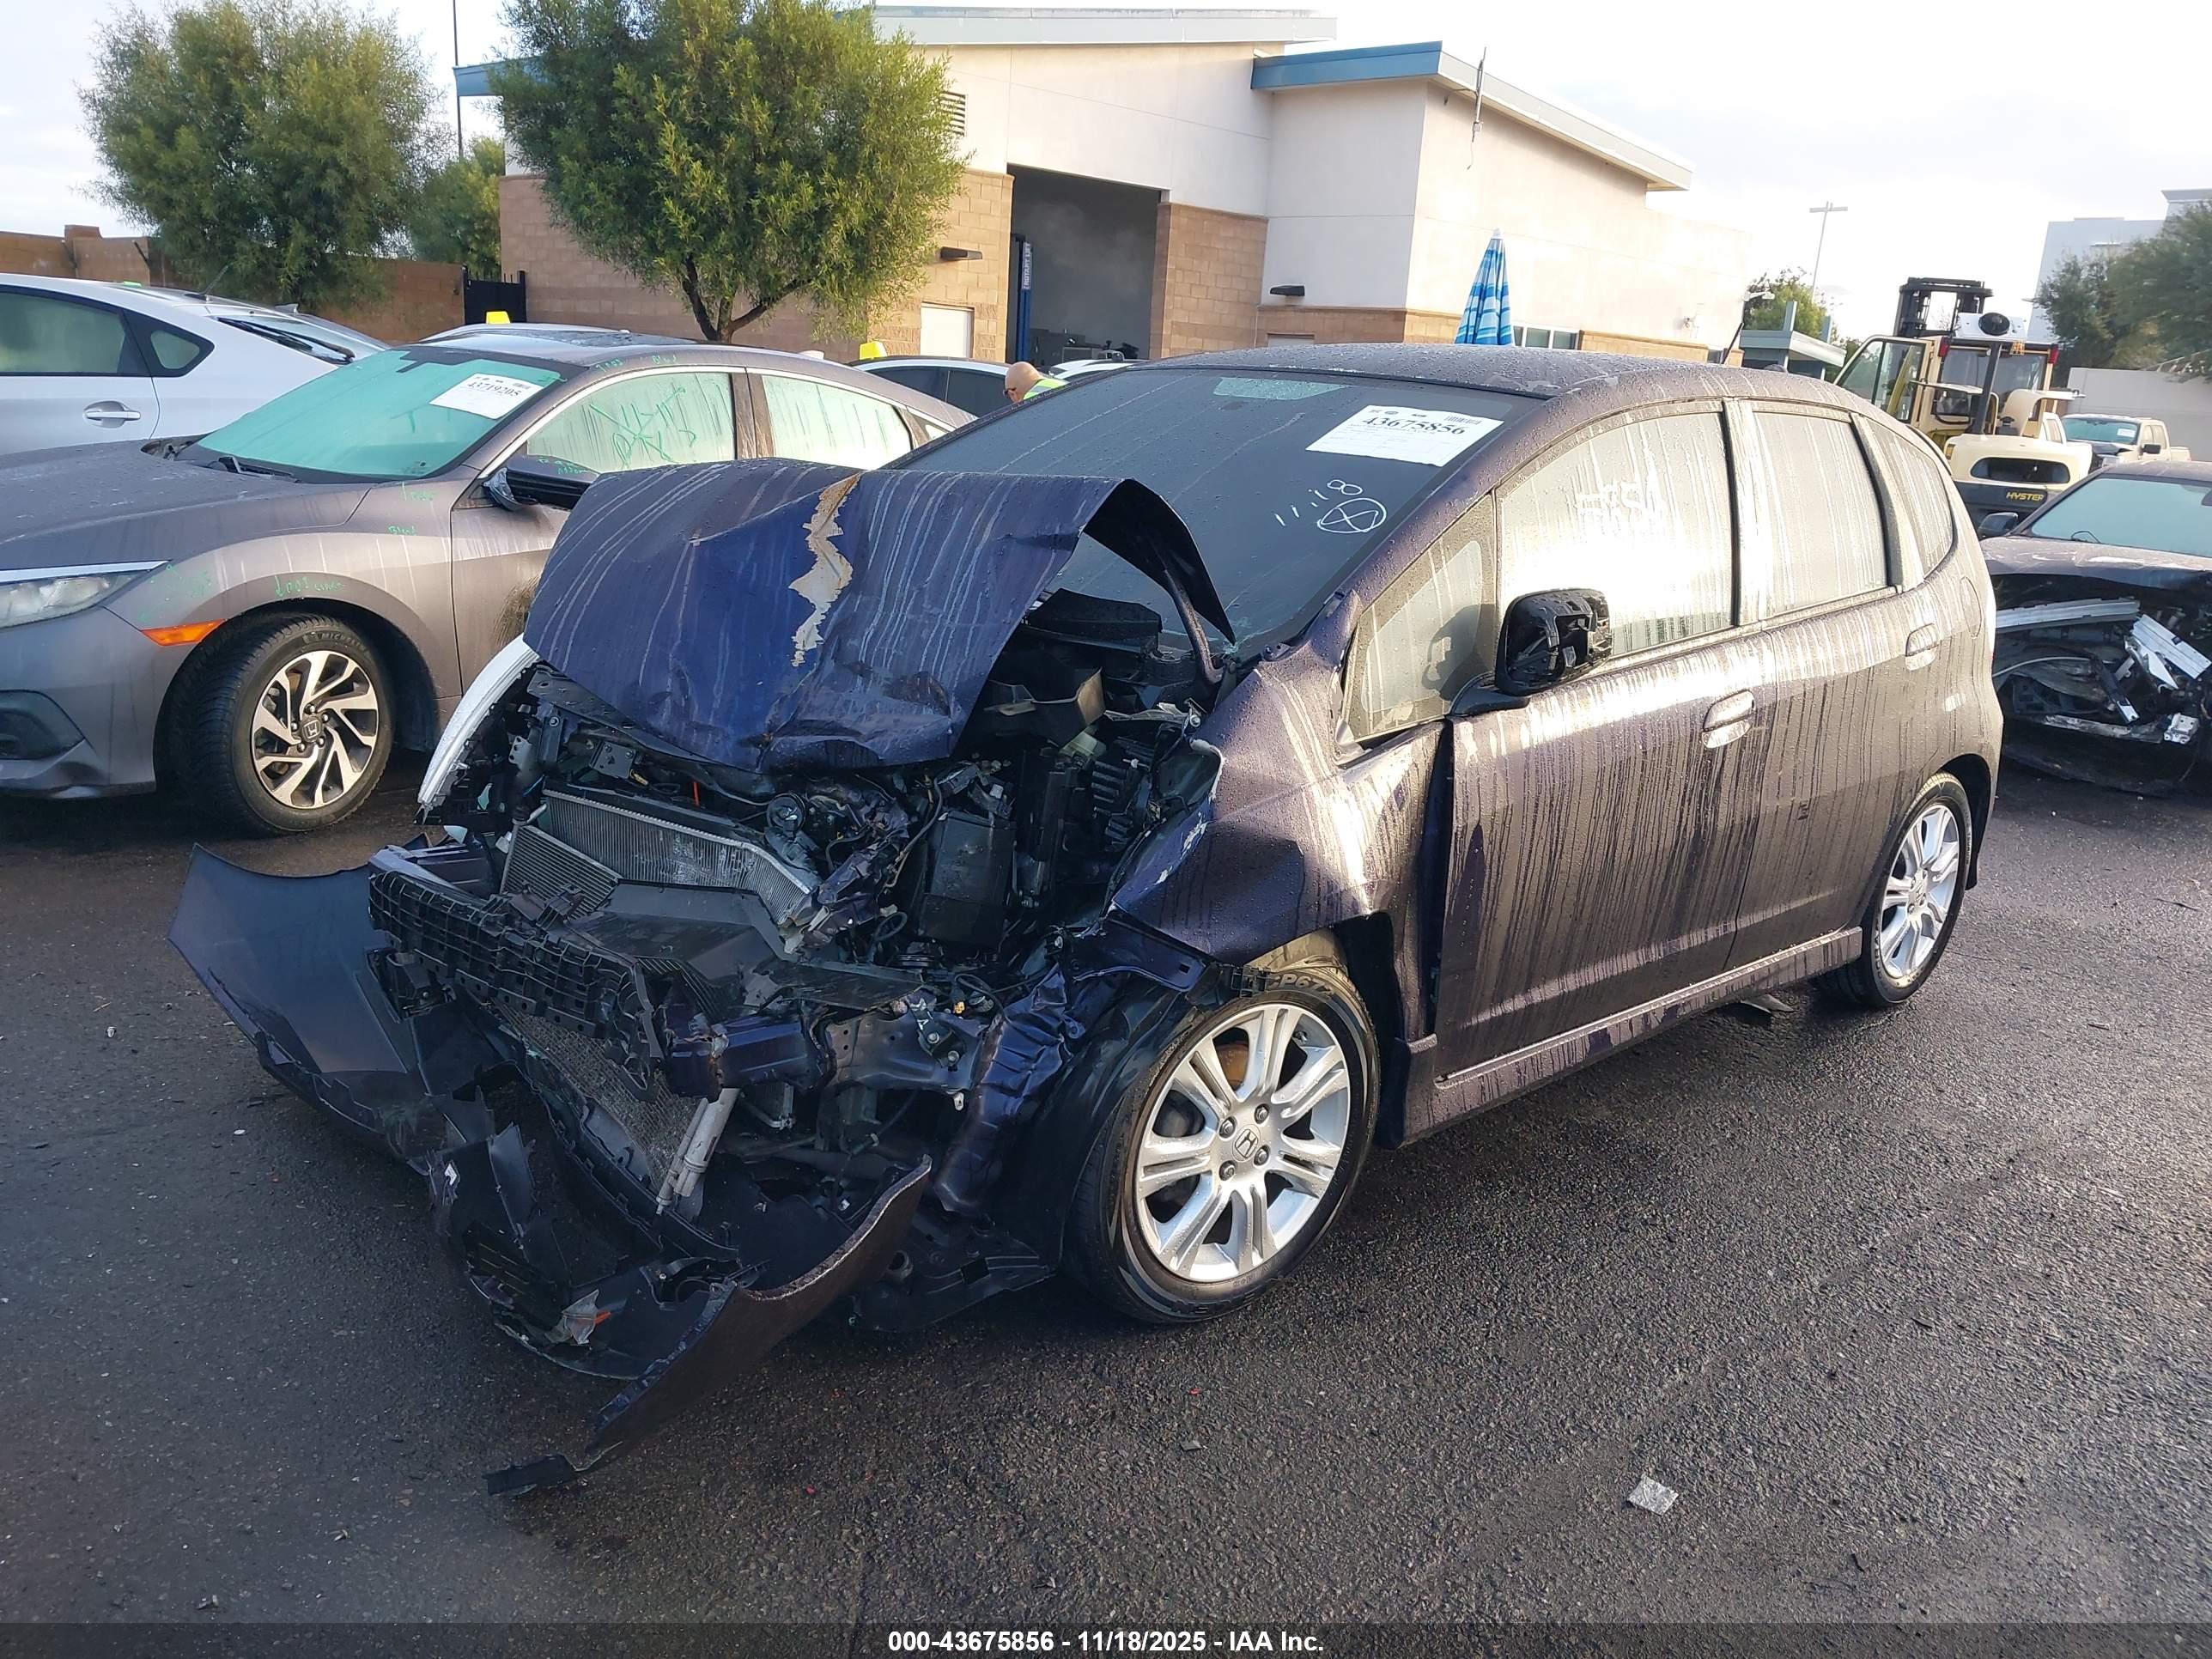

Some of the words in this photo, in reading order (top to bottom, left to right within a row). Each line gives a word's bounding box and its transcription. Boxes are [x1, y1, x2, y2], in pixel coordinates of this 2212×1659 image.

[468, 382, 521, 397] 43719205
[1363, 416, 1468, 434] 43675856
[2005, 491, 2045, 501] HYSTER
